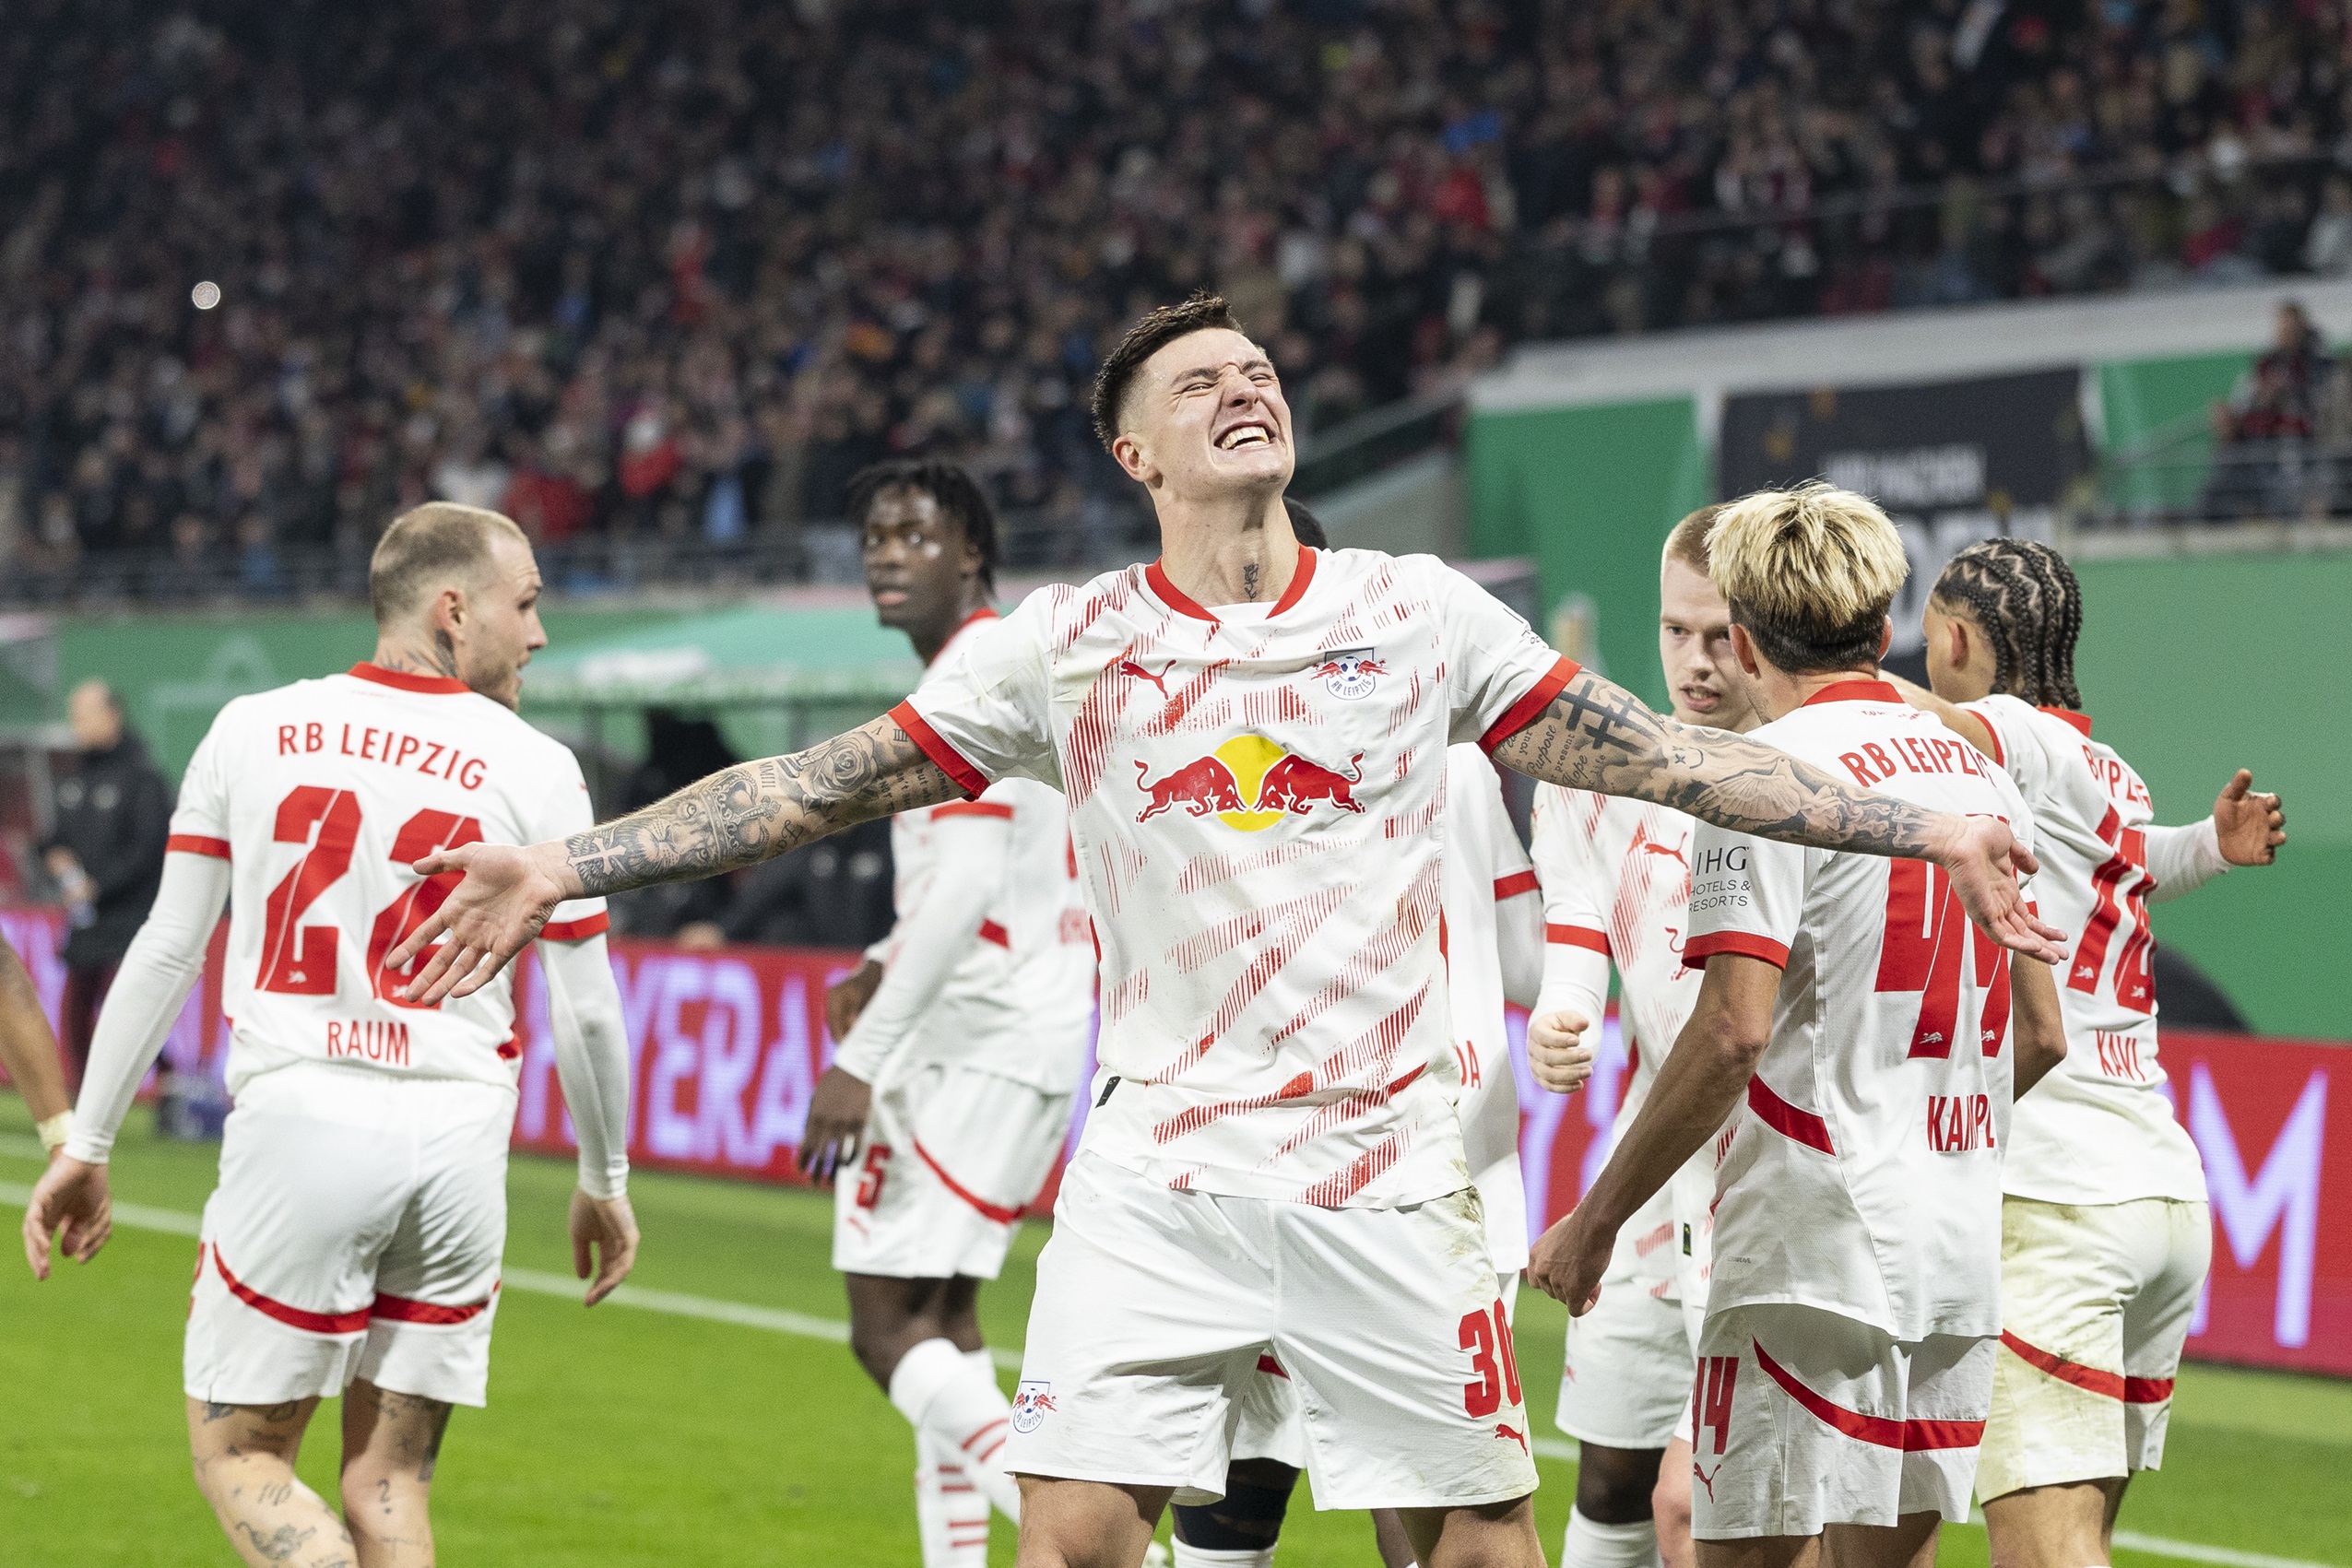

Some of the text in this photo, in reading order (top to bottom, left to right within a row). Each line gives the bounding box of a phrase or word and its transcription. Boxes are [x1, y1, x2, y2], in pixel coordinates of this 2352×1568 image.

[1343, 679, 1371, 696] LEIPZIG
[278, 723, 487, 790] RB LEIPZIG
[1519, 729, 1533, 756] your
[1526, 724, 1556, 776] Purpose
[1554, 733, 1576, 772] present
[1562, 754, 1588, 788] Hope
[1838, 742, 1897, 788] RB
[1696, 845, 1747, 876] IHG
[254, 784, 485, 1010] 22
[1689, 895, 1748, 913] RESORTS
[1691, 879, 1751, 896] HOTELS &
[327, 1020, 409, 1067] RAUM
[856, 1143, 892, 1211] 5
[1459, 1296, 1522, 1420] 30
